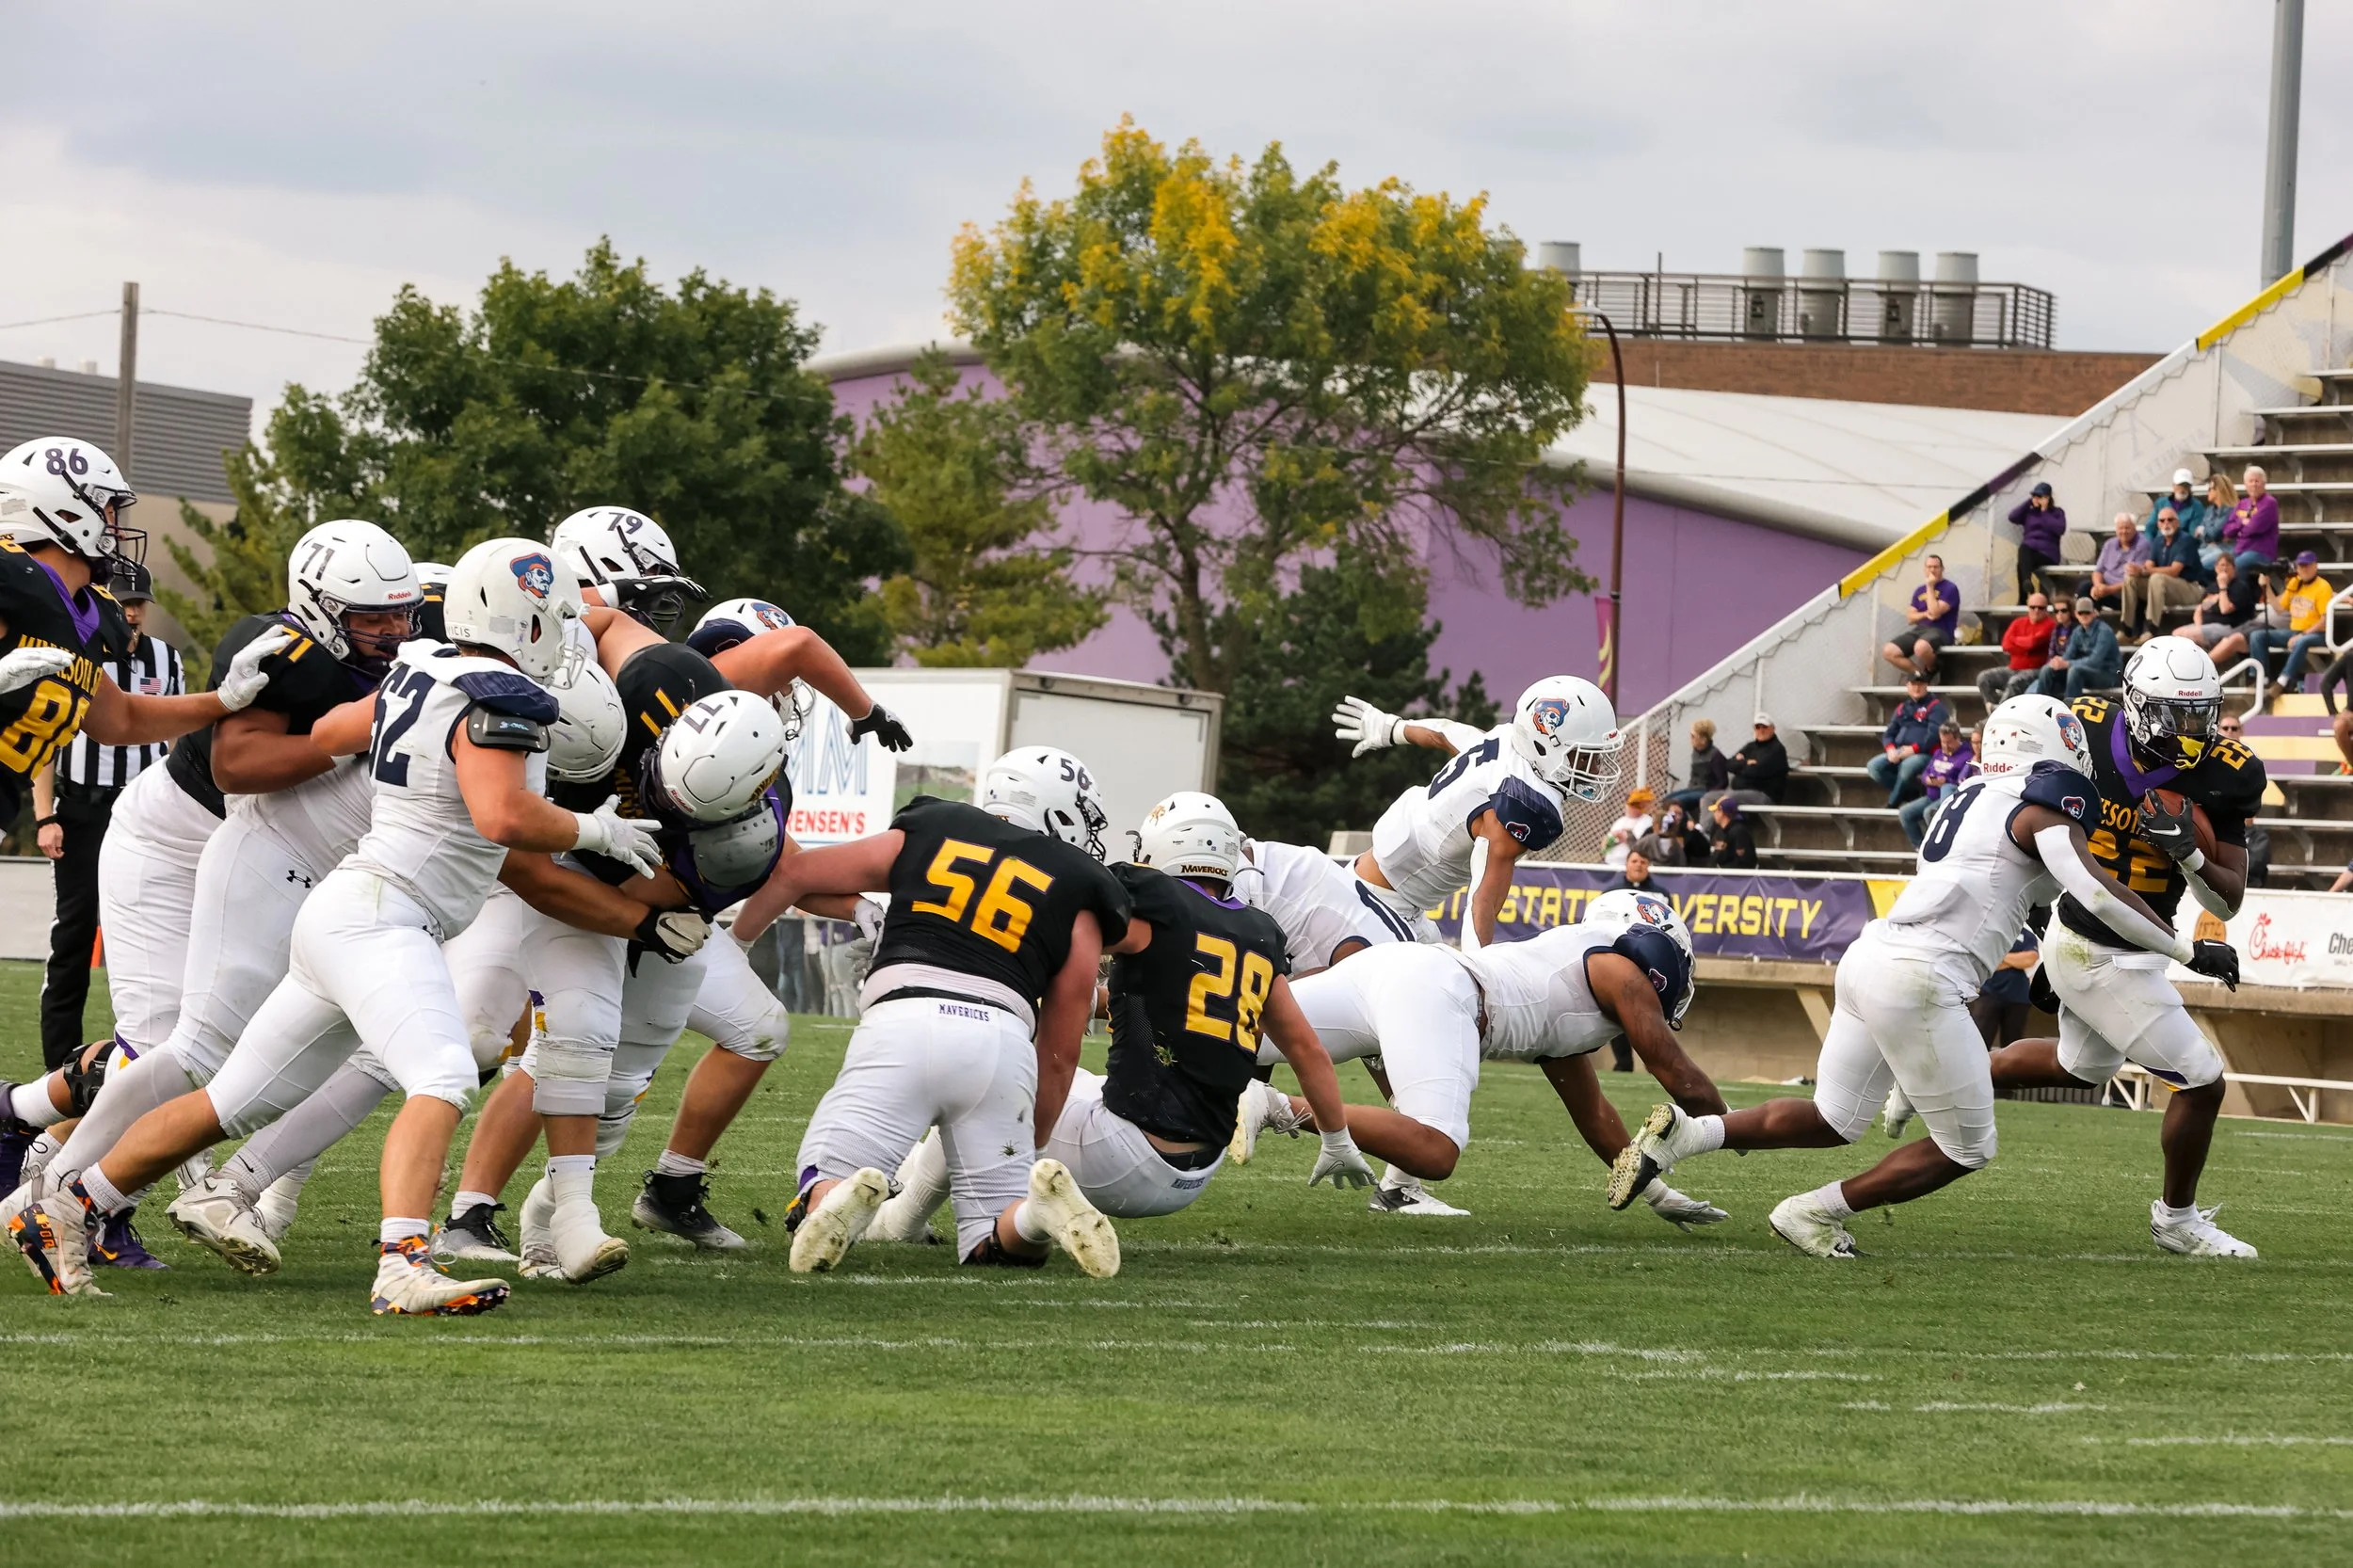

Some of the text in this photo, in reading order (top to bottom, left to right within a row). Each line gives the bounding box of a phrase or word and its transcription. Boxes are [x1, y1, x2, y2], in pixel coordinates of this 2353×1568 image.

[45, 448, 88, 475] 86
[607, 512, 643, 535] 79
[300, 543, 335, 581] 71
[368, 664, 437, 788] 62
[682, 702, 725, 735] 77
[2071, 696, 2109, 724] 22
[2210, 738, 2254, 772] 22
[1060, 757, 1093, 791] 56
[911, 837, 1055, 953] 56
[1184, 931, 1275, 1053] 28
[938, 1003, 990, 1022] MAVERICKS
